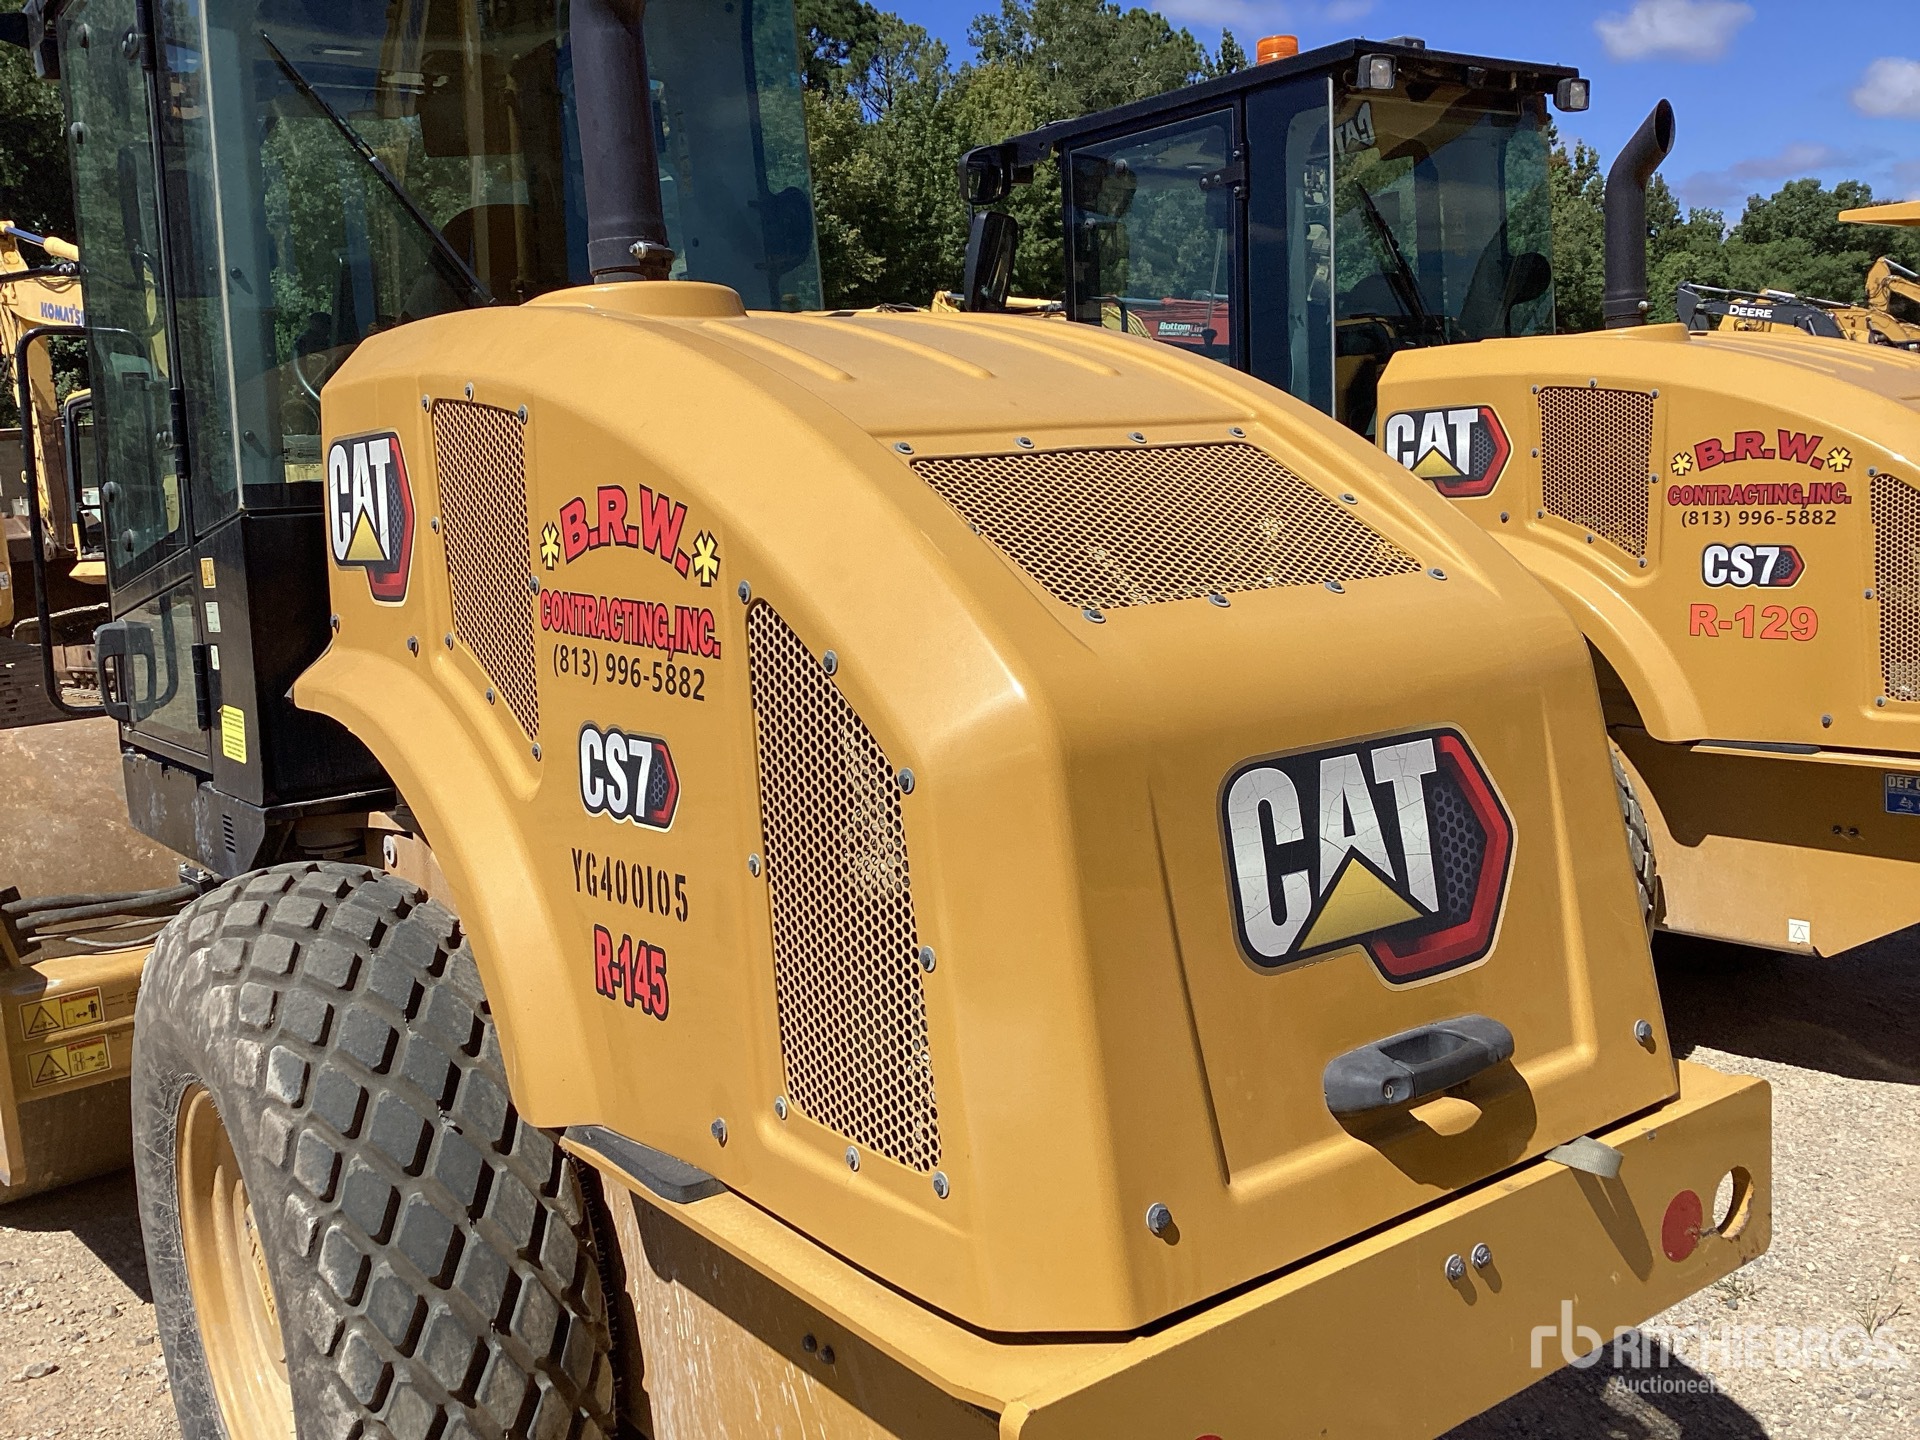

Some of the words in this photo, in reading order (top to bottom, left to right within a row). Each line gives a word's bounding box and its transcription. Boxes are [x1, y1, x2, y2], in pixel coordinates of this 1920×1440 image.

[1728, 304, 1773, 318] DEERE
[1386, 408, 1479, 475] CAT
[1693, 429, 1826, 471] B.R.W.
[329, 437, 391, 562] CAT
[1681, 510, 1731, 528] (813)
[1738, 509, 1837, 526] 996-5882
[560, 483, 691, 580] B.R.W.
[1703, 545, 1780, 585] CS7
[1689, 603, 1818, 641] R-129
[553, 644, 598, 686] (813)
[605, 652, 706, 702] 996-5882
[580, 728, 652, 818] CS7
[1888, 776, 1912, 789] DEF
[1228, 738, 1439, 957] CAT
[594, 923, 669, 1022] R-145
